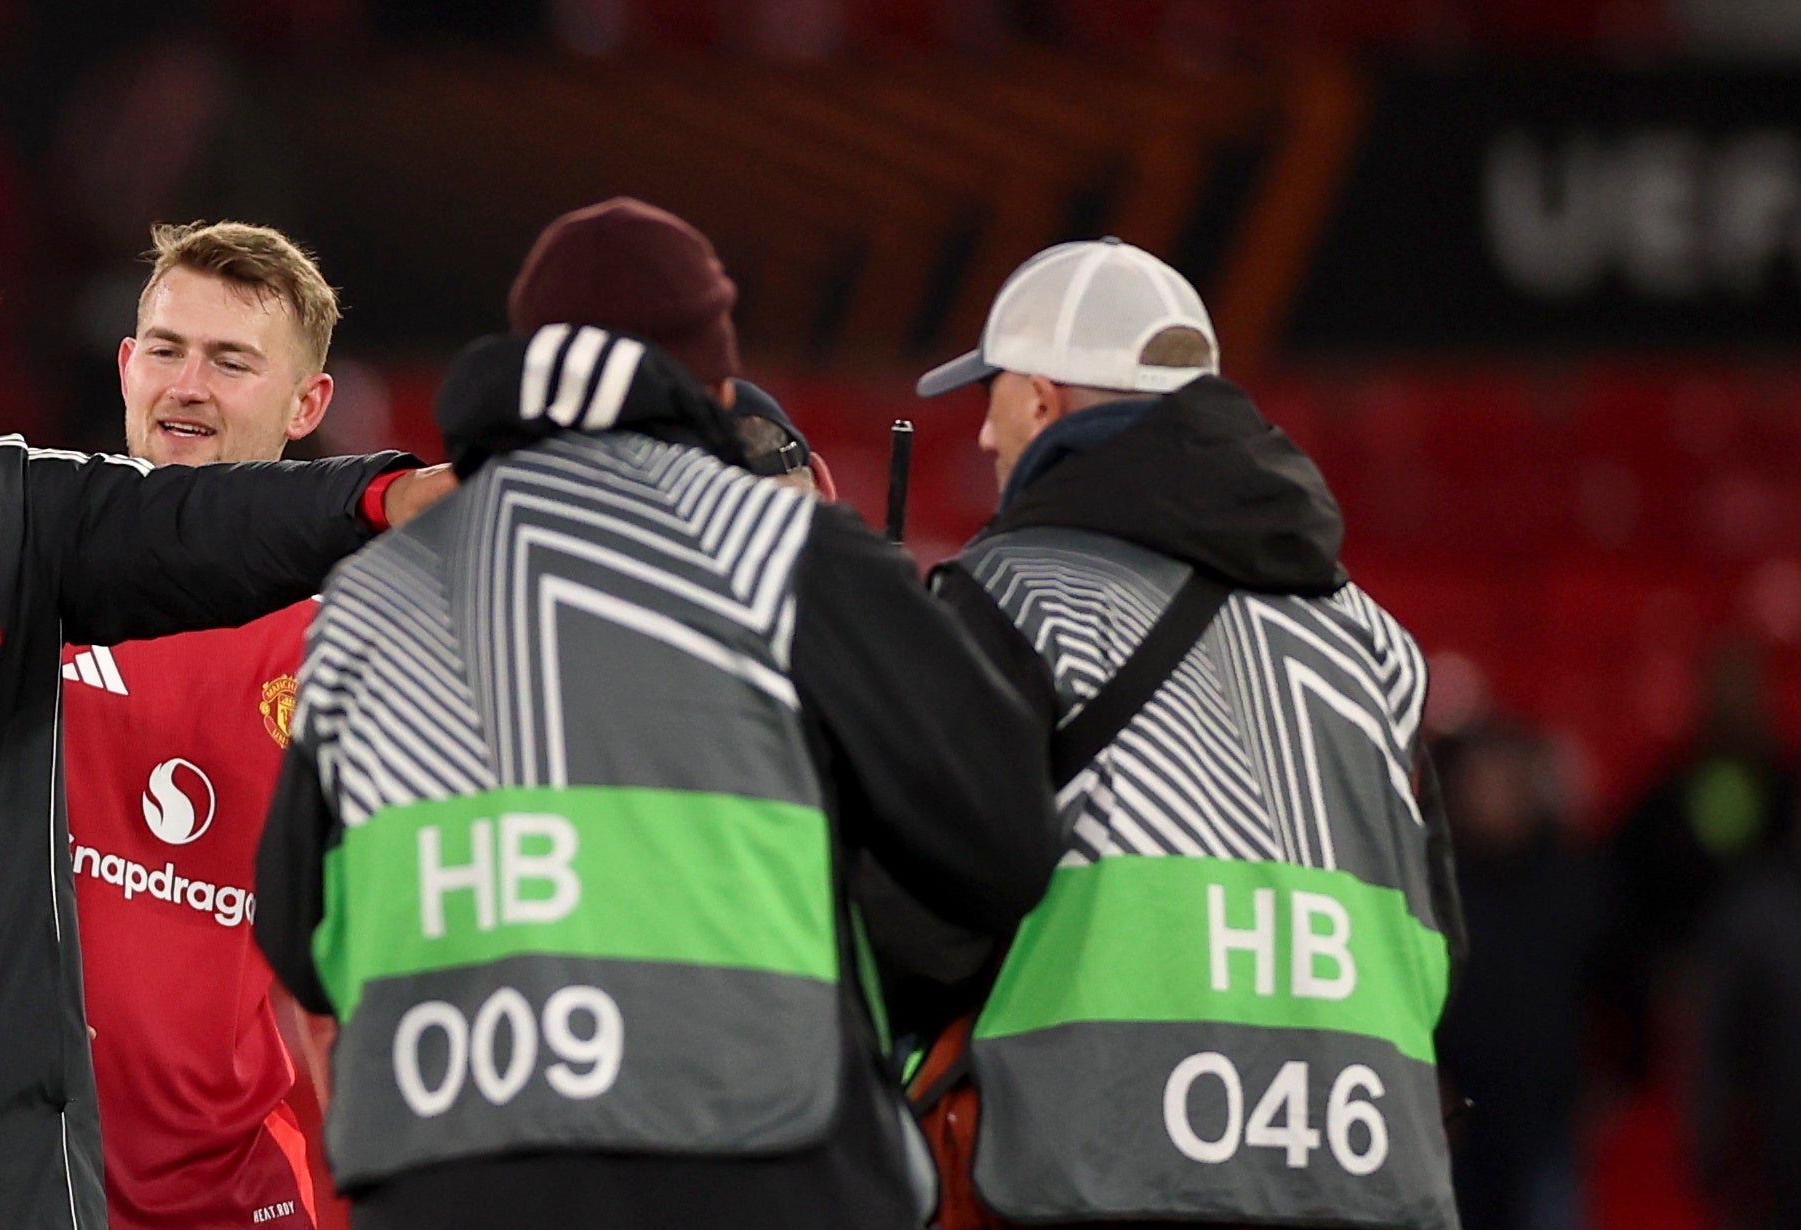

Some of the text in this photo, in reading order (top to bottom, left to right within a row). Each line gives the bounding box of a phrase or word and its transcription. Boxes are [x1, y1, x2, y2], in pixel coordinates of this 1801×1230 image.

[1481, 122, 1801, 298] UEF
[69, 833, 256, 927] napdrag
[416, 811, 583, 941] HB
[1206, 883, 1357, 1001] HB
[392, 984, 625, 1117] 009
[1162, 1051, 1389, 1176] 046
